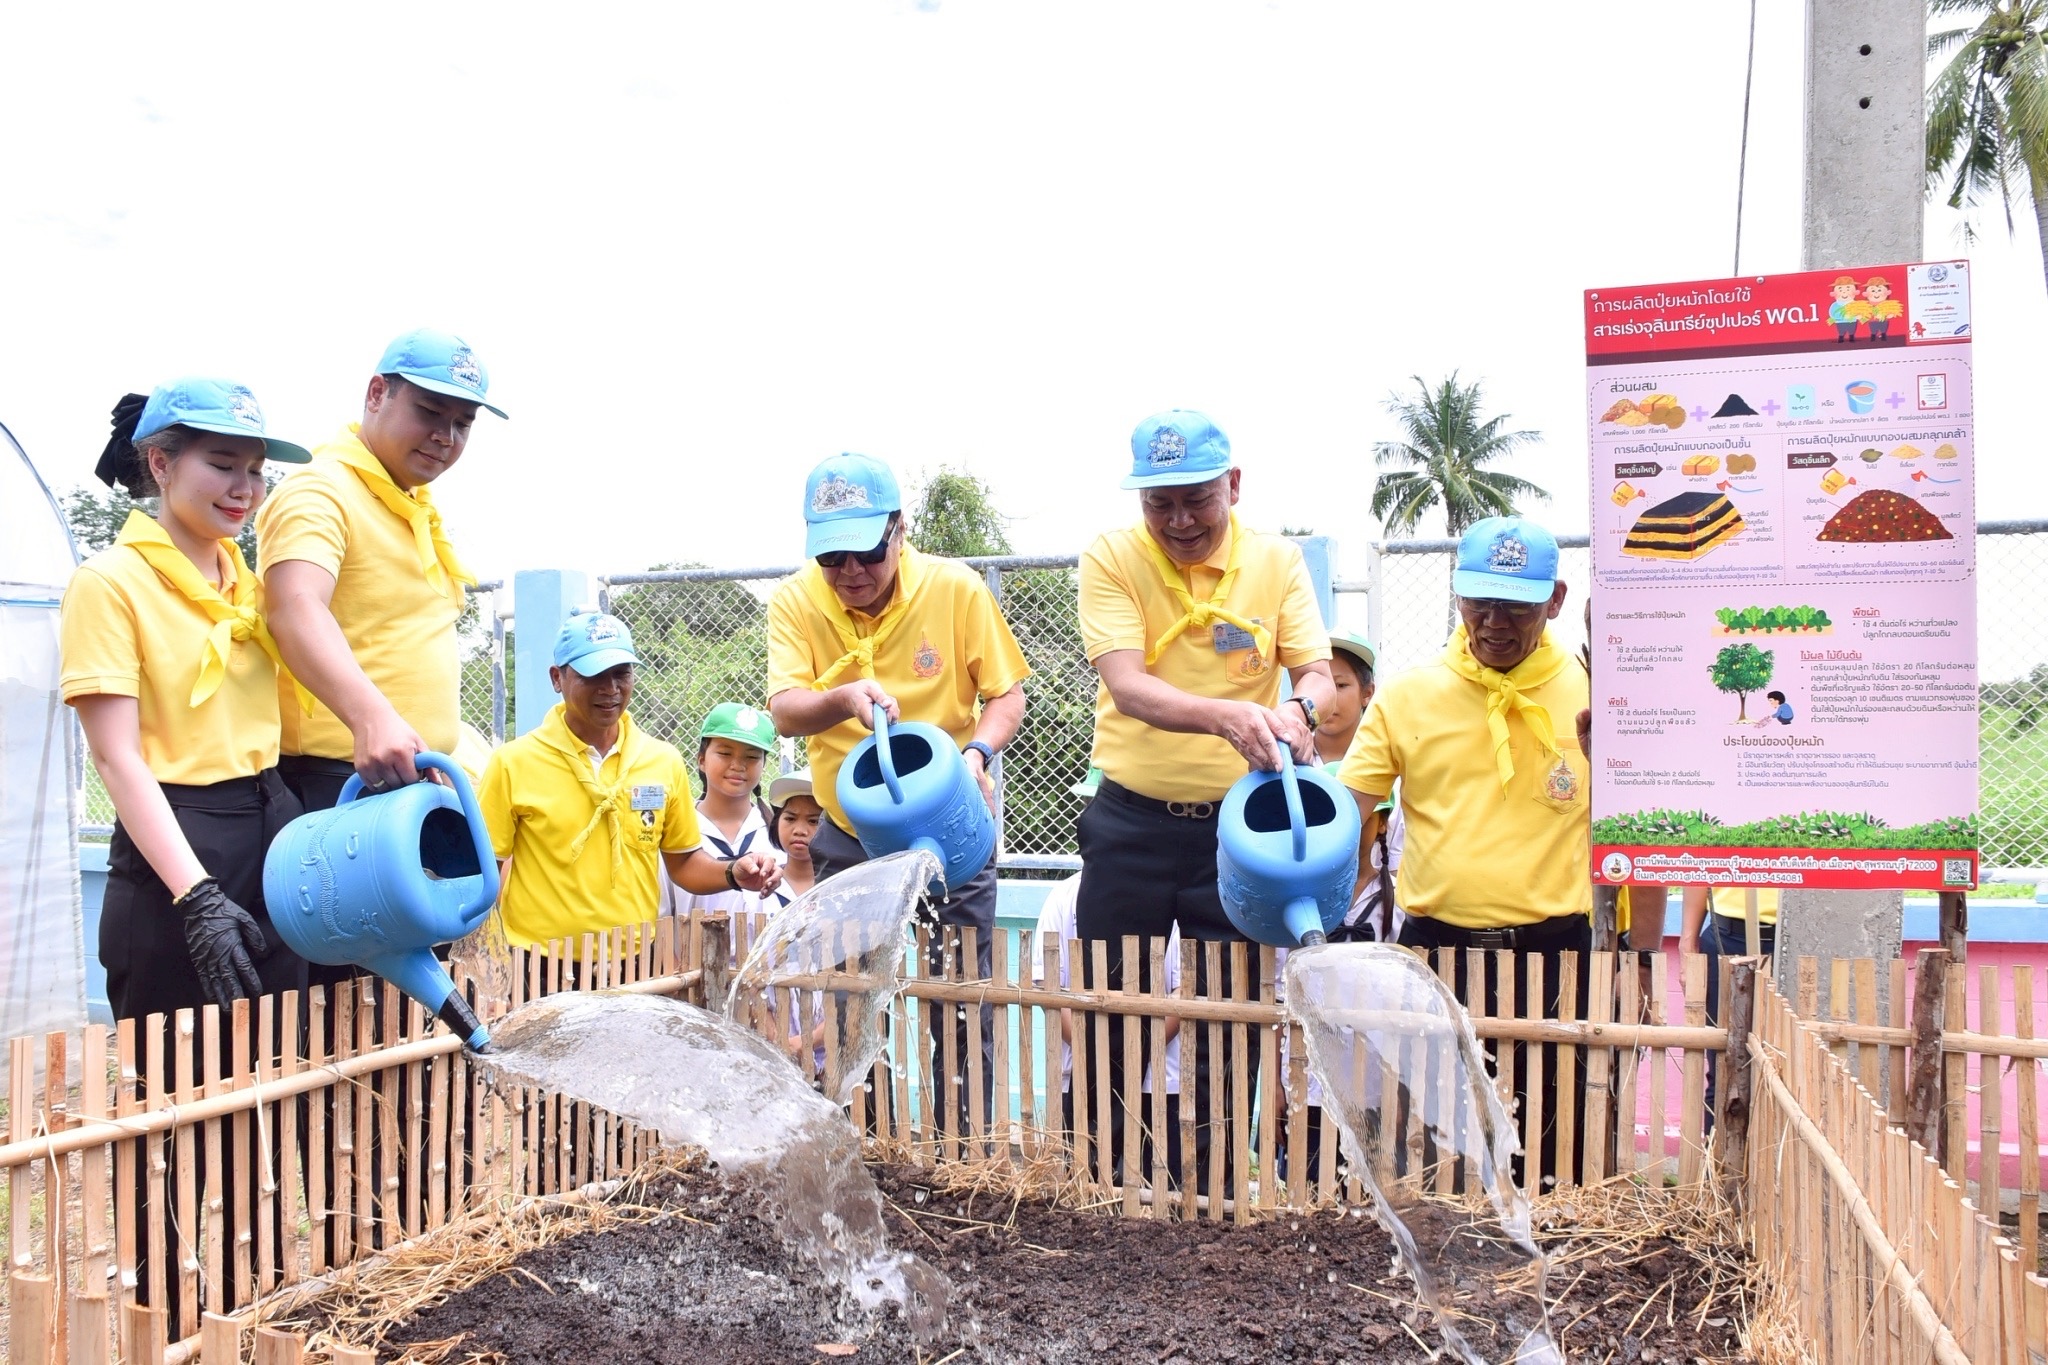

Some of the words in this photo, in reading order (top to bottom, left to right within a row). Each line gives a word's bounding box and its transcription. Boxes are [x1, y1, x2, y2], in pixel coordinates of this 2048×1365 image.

[1594, 286, 1752, 313] การผลิตปุ๋ยหมักโดยใช้
[1593, 309, 1761, 339] สารเร่งจุลินทรีย์ซุปเปอร์
[1765, 303, 1820, 325] พด.1
[1610, 380, 1658, 393] ส่วนผสม
[1821, 399, 1834, 407] หรือ
[1787, 429, 1967, 447] การผลิตปุ๋ยหมักแบบกองผสมคลุกเคล้า
[1606, 610, 1686, 621] อัตราและวิธีการใช้ปุ๋ยหมัก
[1853, 606, 1880, 617] พืชผัก
[1863, 619, 1872, 628] ใช้
[1879, 619, 1907, 628] ตันต่อไร่
[1909, 617, 1958, 628] หว่านทั่วแปลง
[1608, 635, 1623, 644] ข้าว
[1632, 645, 1657, 653] ตันต่อไร่
[1801, 650, 1824, 660] ไม้ผล
[1827, 650, 1862, 660] ไม้ยืนต้น
[1872, 662, 1900, 671] ใช้อัตรา
[1916, 661, 1975, 673] กิโลกรัมต่อหลุม
[1873, 682, 1899, 691] ใช้อัตรา
[1926, 682, 1975, 691] กิโลกรัมต่อต้น
[1608, 697, 1628, 706] พืชไร่
[1632, 708, 1658, 716] ตันต่อไร่
[1723, 735, 1825, 750] ประโยชน์ของปุ๋ยหมัก
[1607, 758, 1632, 767] ไม้ดอก
[1741, 859, 1752, 867] 74
[1755, 859, 1768, 867] ม.4
[1856, 859, 1906, 872] จ.สุพรรณบุรี
[1908, 861, 1936, 870] 72000
[1635, 870, 1655, 880] อีเมล
[1734, 871, 1748, 881] โทร
[1751, 873, 1802, 882] 035-454081
